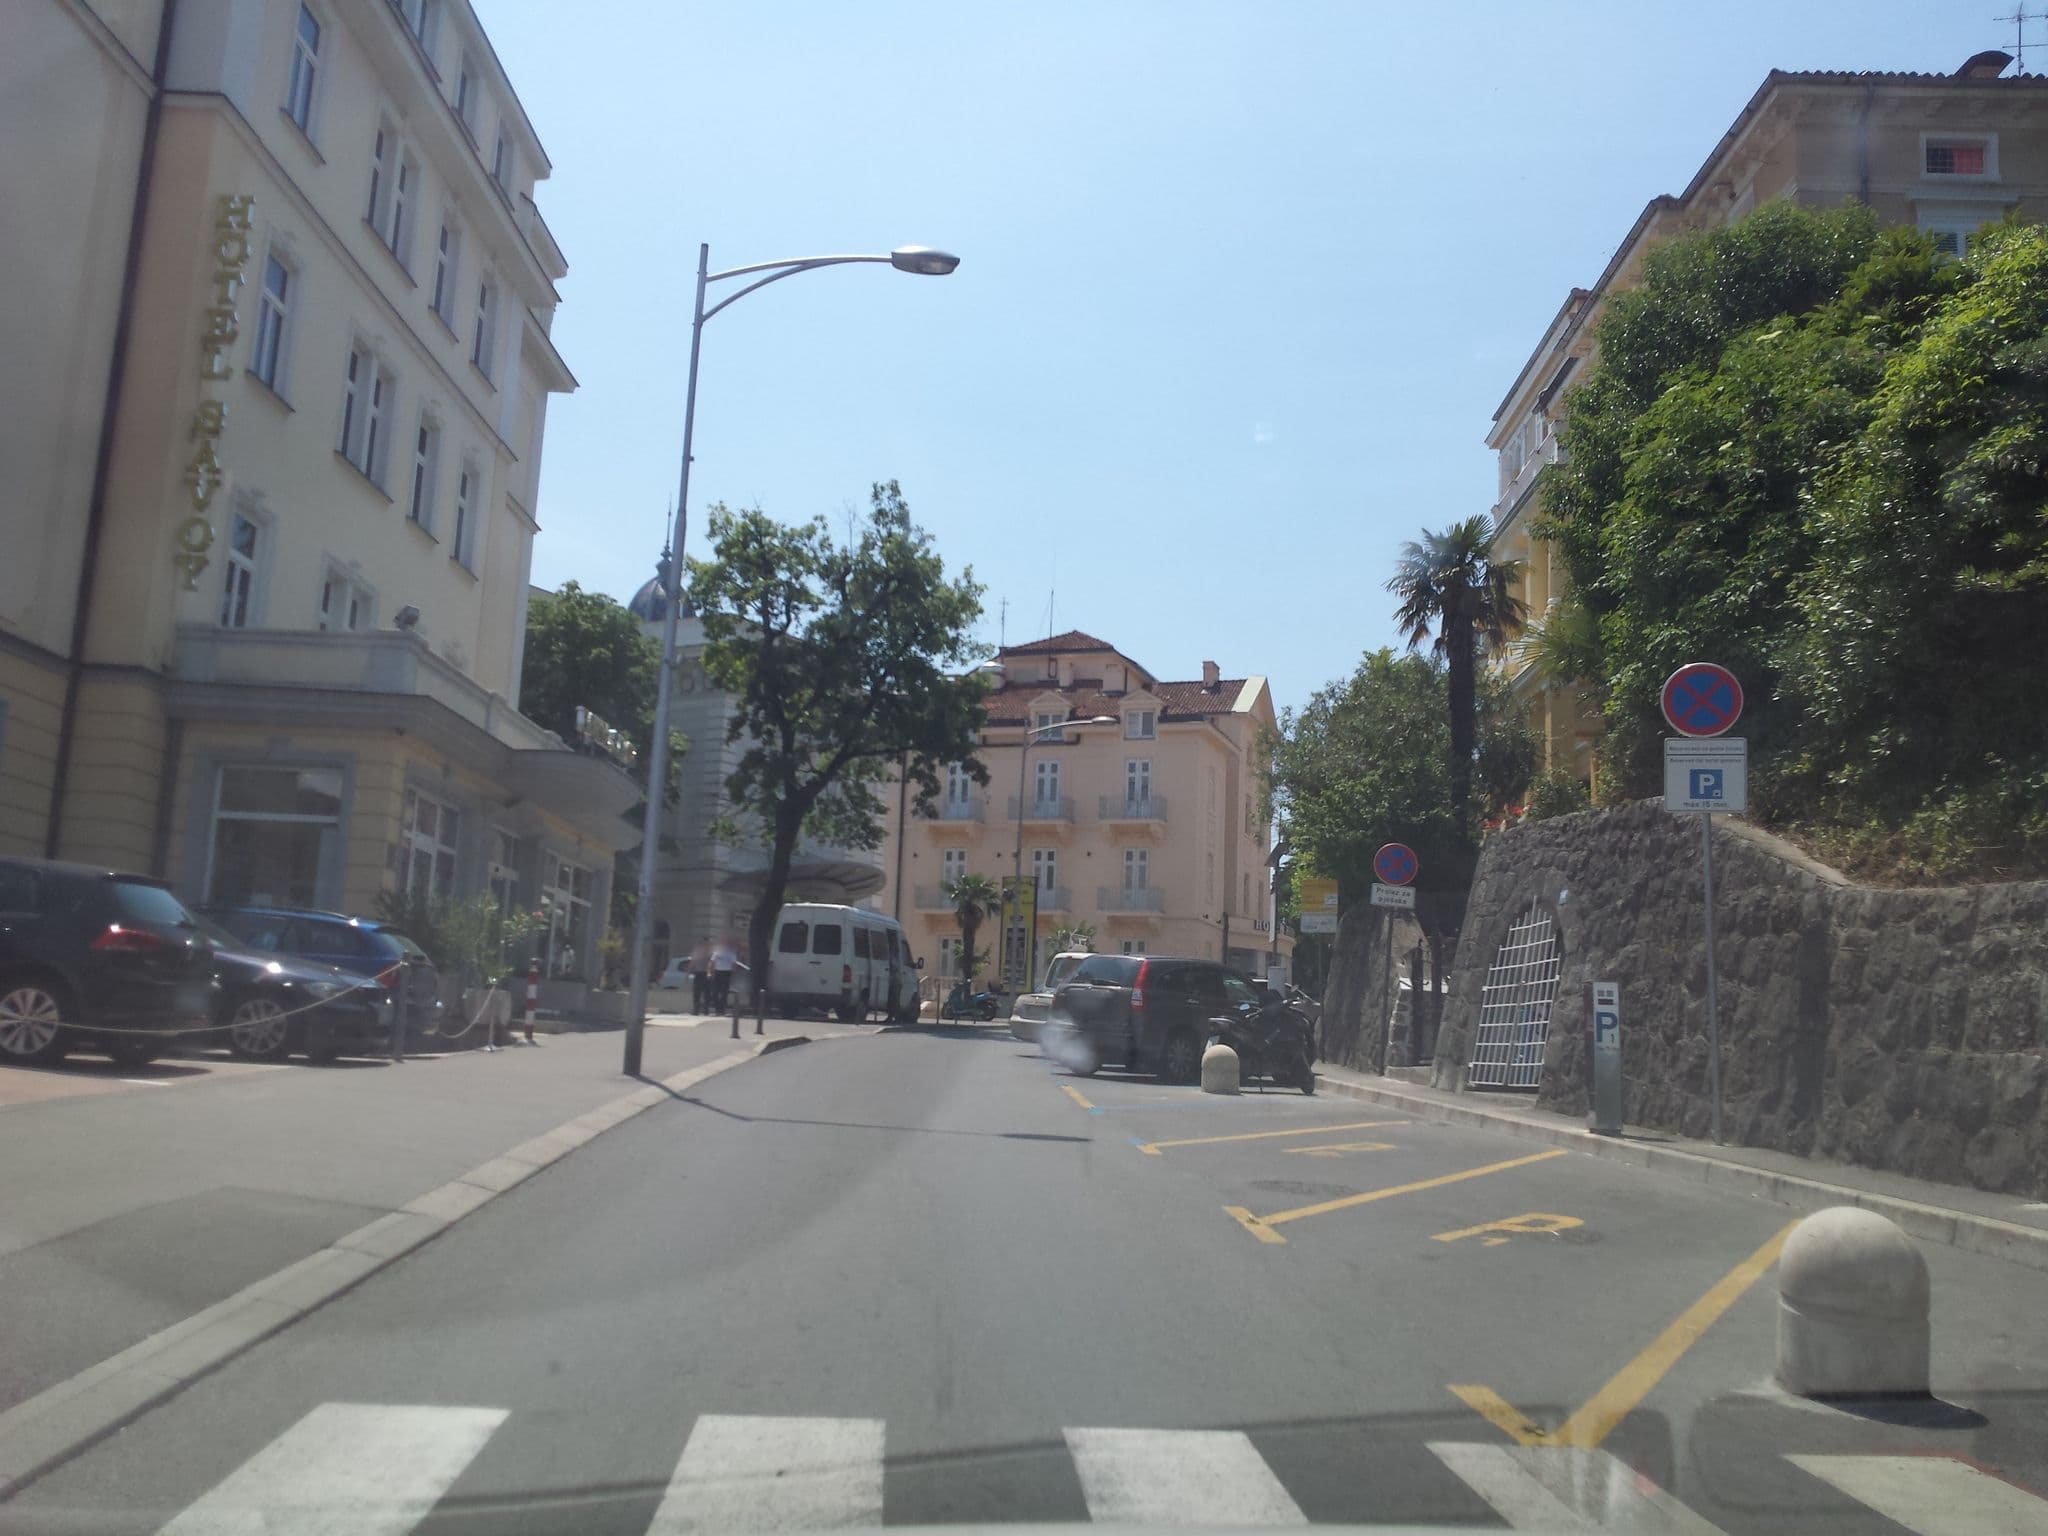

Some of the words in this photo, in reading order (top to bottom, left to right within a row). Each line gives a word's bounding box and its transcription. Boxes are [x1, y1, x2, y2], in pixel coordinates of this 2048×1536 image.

[203, 194, 256, 381] HOTEL
[1699, 773, 1715, 795] P
[1595, 1011, 1618, 1043] P
